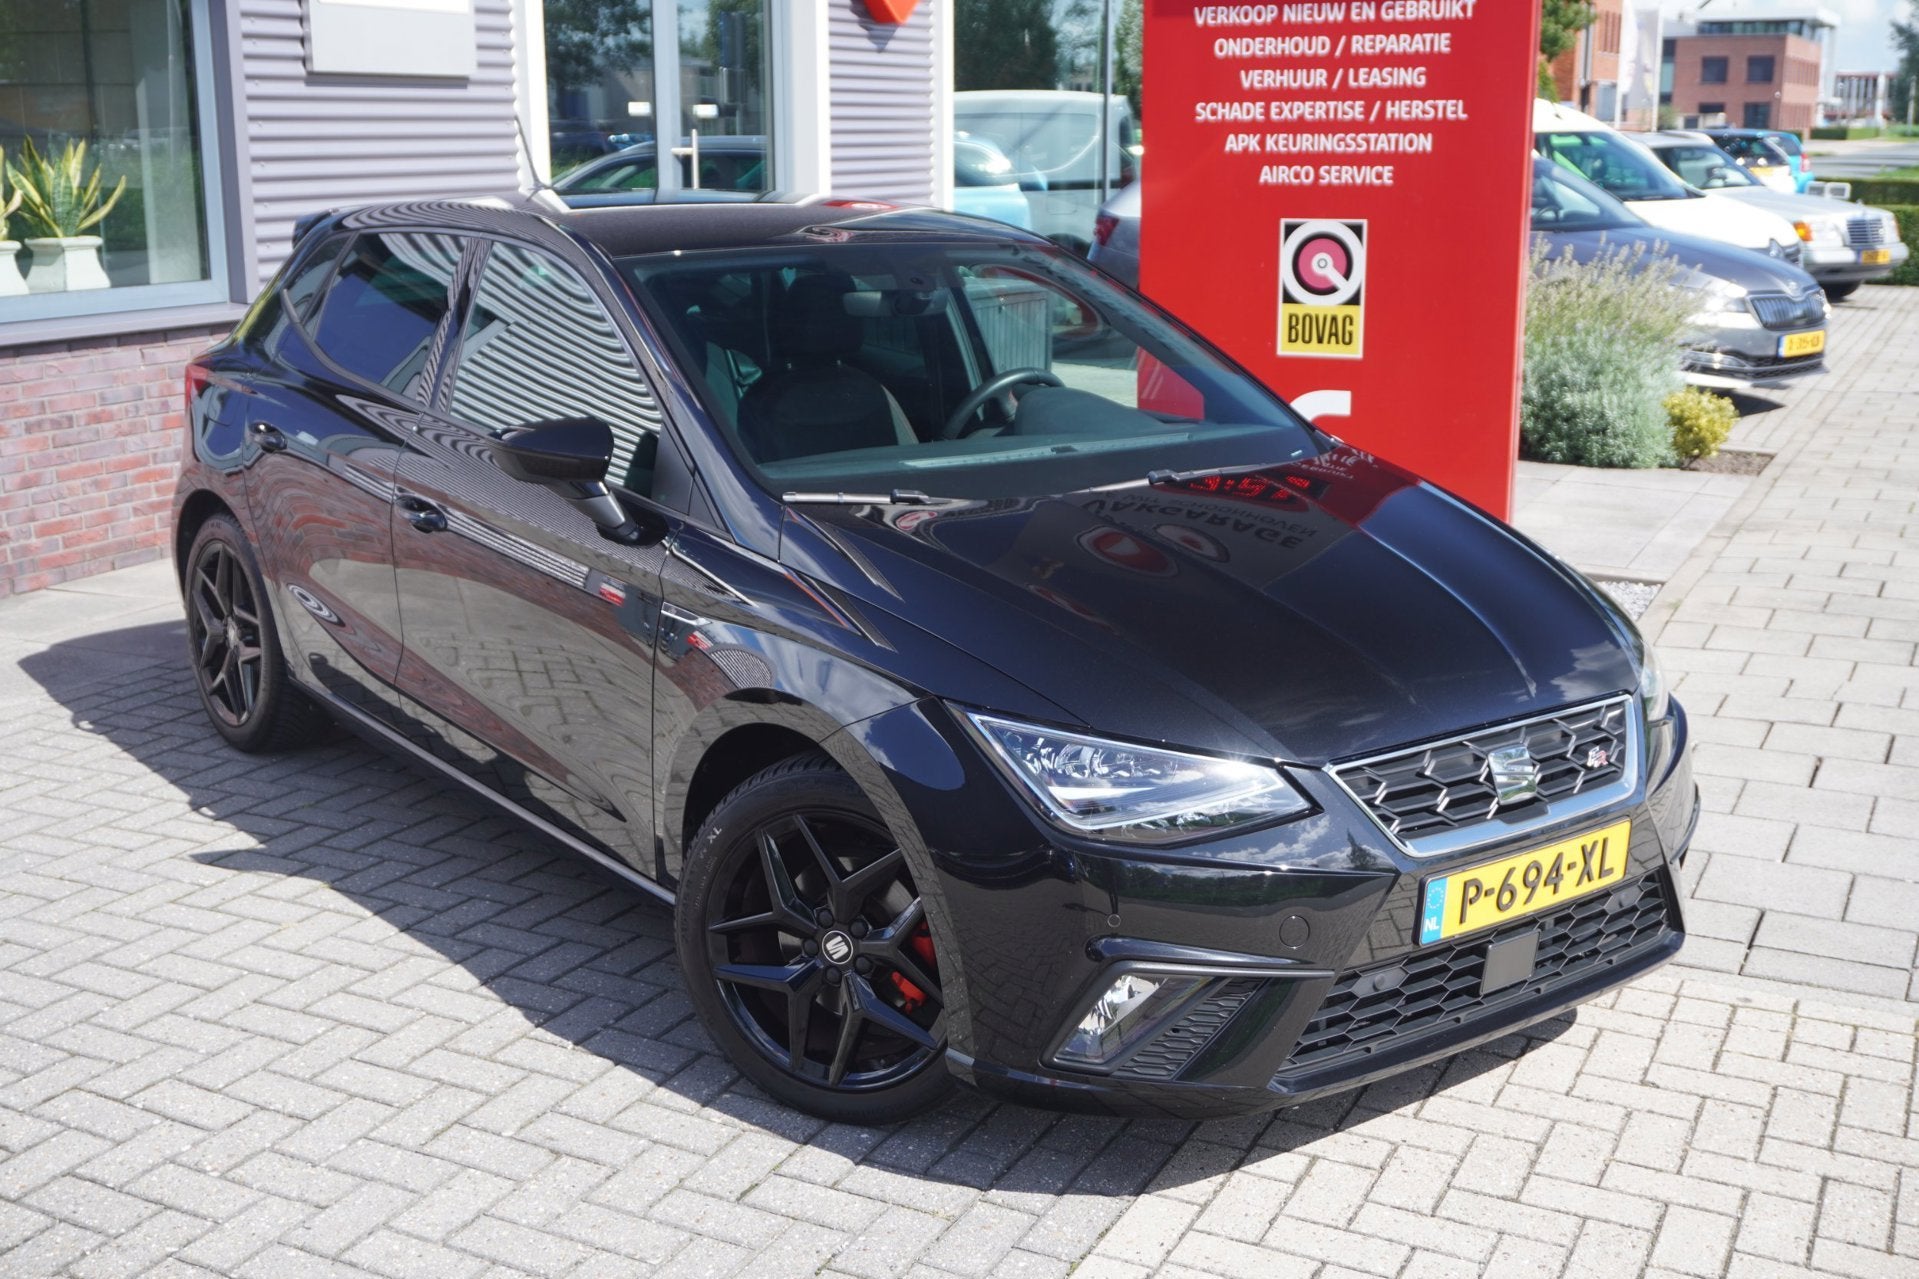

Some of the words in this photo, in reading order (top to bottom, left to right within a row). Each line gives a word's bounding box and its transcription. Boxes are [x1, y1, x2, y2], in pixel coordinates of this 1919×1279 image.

[1194, 4, 1279, 28] VERKOOP
[1282, 2, 1346, 25] NIEUW
[1350, 1, 1376, 23] EN
[1380, 0, 1477, 22] GEBRUIKT
[1213, 35, 1331, 59] ONDERHOUD
[1334, 35, 1347, 58] /
[1350, 32, 1451, 56] REPARATIE
[1240, 68, 1328, 91] VERHUUR
[1331, 68, 1344, 91] /
[1347, 66, 1427, 90] LEASING
[1195, 101, 1266, 123] SCHADE
[1269, 100, 1365, 122] EXPERTISE
[1369, 100, 1381, 123] /
[1385, 99, 1468, 122] HERSTEL
[1224, 133, 1261, 154] APK
[1265, 132, 1433, 154] KEURINGSSTATION
[1259, 165, 1315, 186] AIRCO
[1318, 165, 1394, 187] SERVICE
[1287, 313, 1354, 346] BOVAG
[1459, 837, 1615, 925] P-694-XL
[1424, 916, 1440, 932] NL
